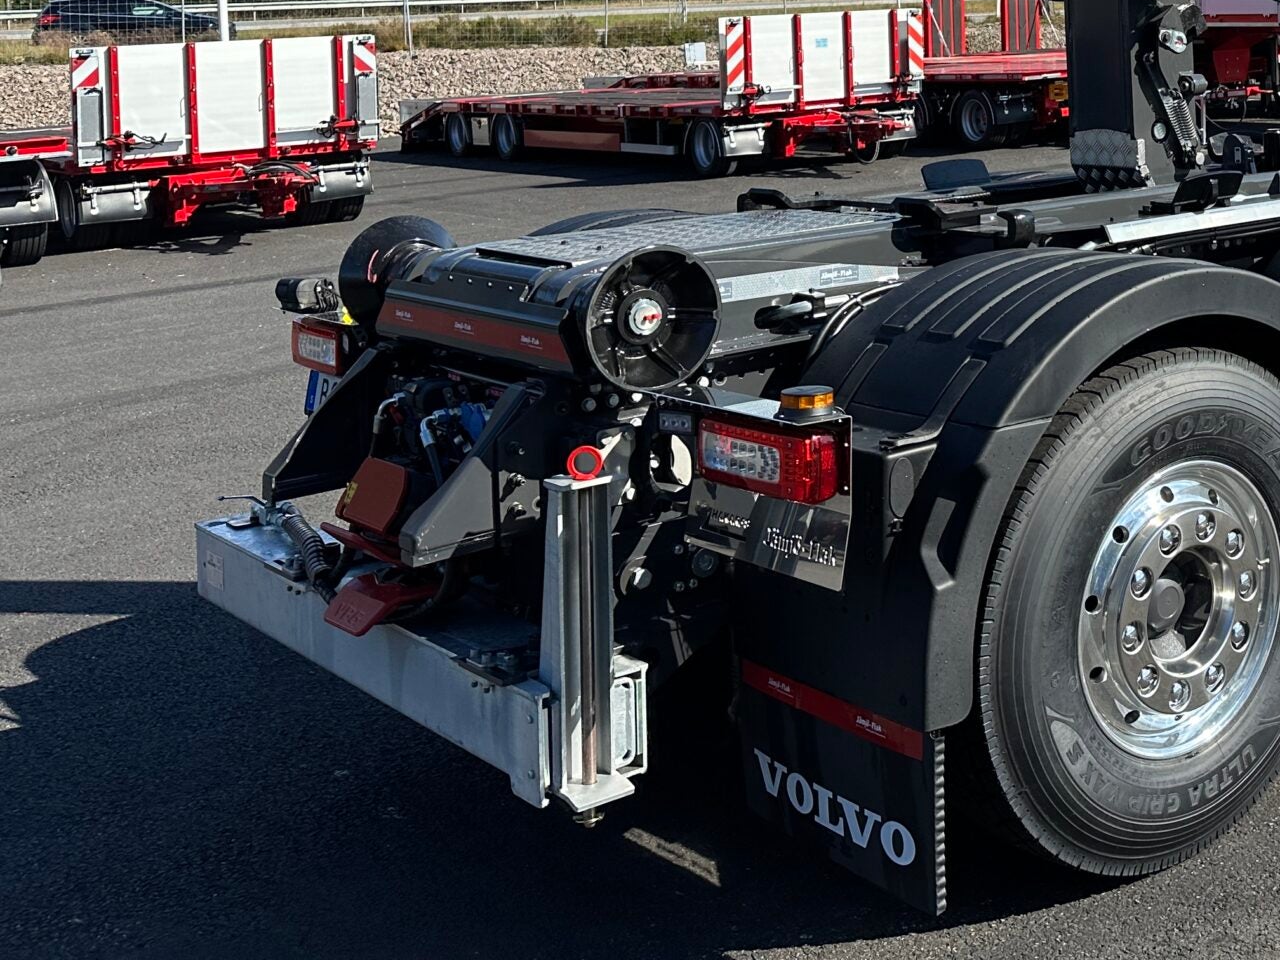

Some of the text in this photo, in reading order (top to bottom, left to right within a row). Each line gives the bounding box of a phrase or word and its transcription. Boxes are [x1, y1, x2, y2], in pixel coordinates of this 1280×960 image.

[1065, 742, 1086, 766] S
[1188, 742, 1257, 806] ULTRA
[753, 747, 917, 866] VOLVO
[1127, 793, 1182, 816] GRIP
